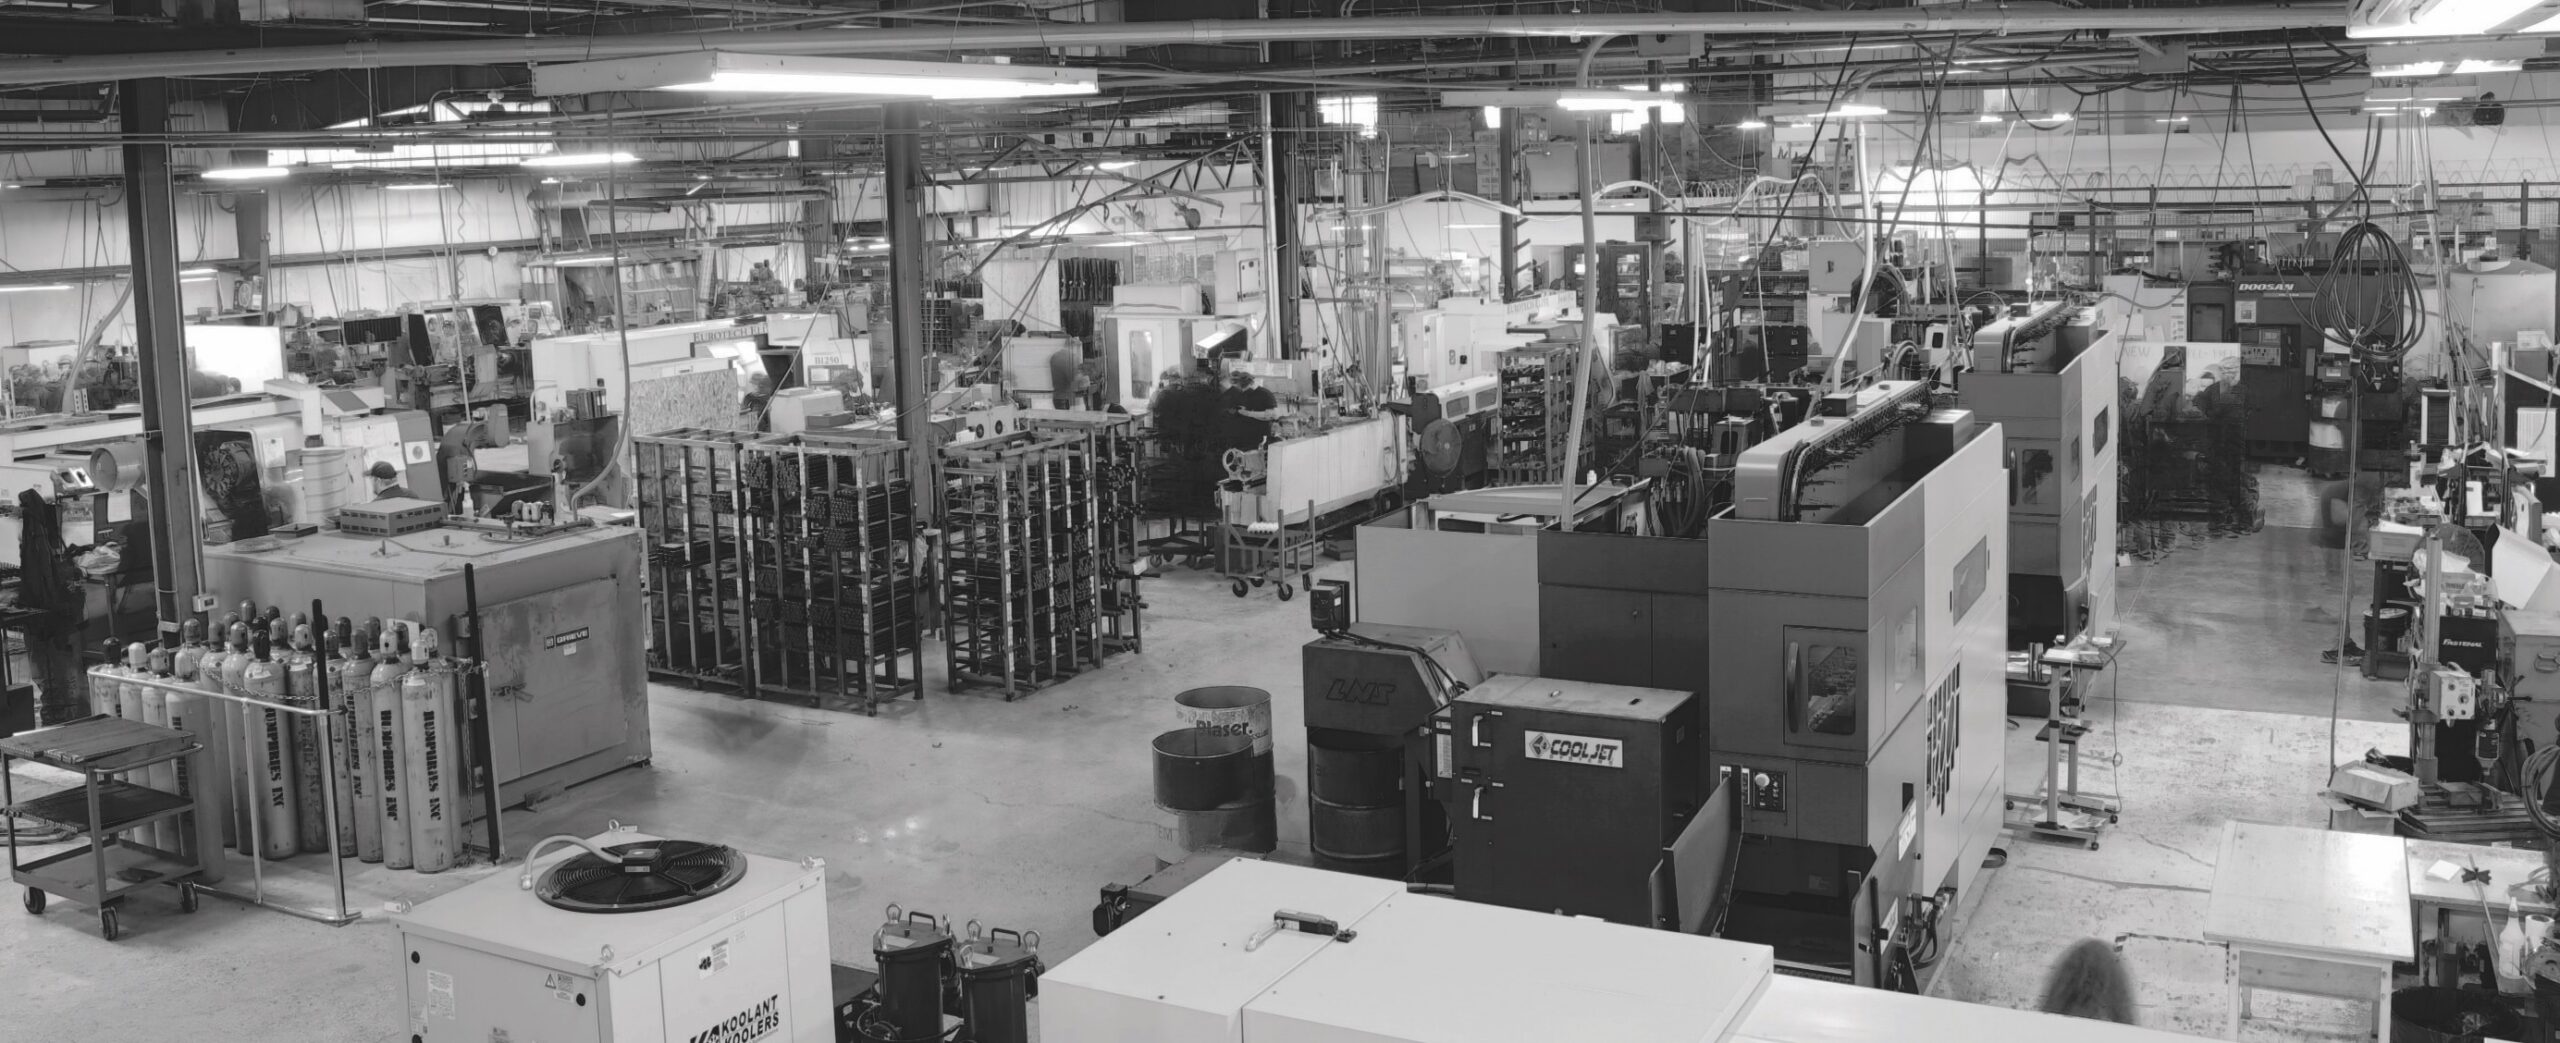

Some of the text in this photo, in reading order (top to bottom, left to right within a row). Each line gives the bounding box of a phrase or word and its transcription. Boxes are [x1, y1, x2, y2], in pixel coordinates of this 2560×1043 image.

[2239, 283, 2294, 291] DOOSAN
[1326, 679, 1397, 706] LNS
[380, 709, 398, 821] HUMPHRIES INC
[423, 710, 442, 821] HUMPHRIES INC
[722, 993, 779, 1038] KOOLANT
